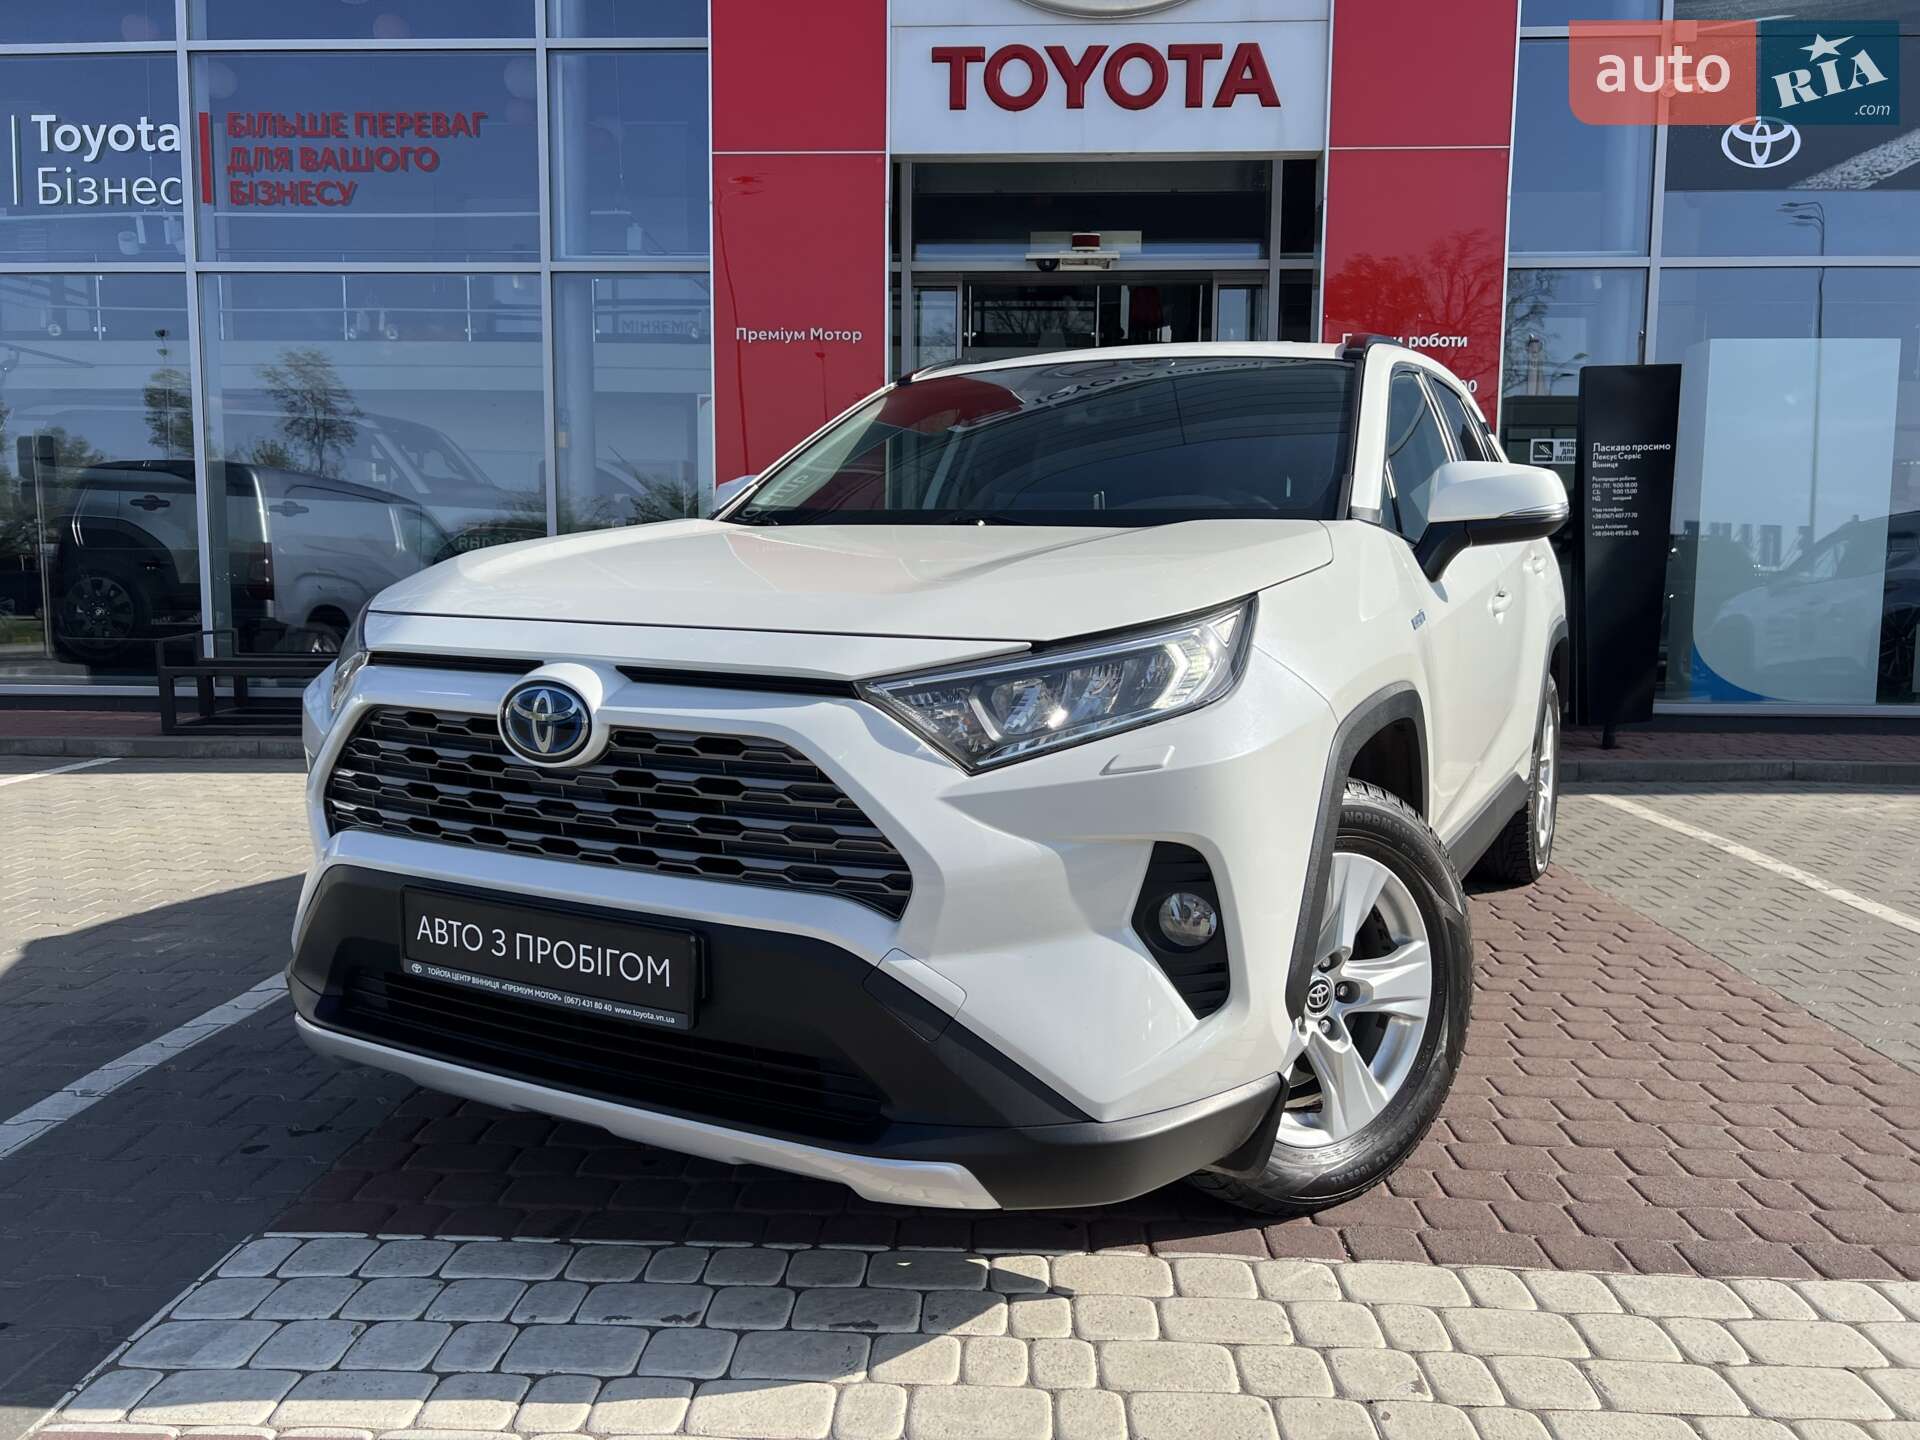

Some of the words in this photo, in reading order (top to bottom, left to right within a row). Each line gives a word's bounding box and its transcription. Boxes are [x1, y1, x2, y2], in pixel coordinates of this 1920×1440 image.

[931, 43, 1282, 111] TOYOTA
[31, 114, 181, 162] Toyota
[226, 112, 349, 138] БІЛЬШЕ
[354, 112, 488, 138] ПЕРЕВАГ
[226, 146, 292, 174] ДЛЯ
[299, 146, 441, 174] ВАШОГО
[37, 167, 182, 206] Бізнес
[229, 180, 357, 206] БІЗНЕСУ
[736, 327, 806, 344] Преміум
[810, 328, 863, 344] Мотор
[1408, 333, 1469, 349] роботи
[1632, 443, 1671, 453] просимо
[416, 915, 483, 951] АВТО
[491, 929, 506, 957] З
[516, 932, 670, 988] ПРОБІГОМ
[427, 967, 451, 979] ТОЙОТА
[451, 972, 471, 983] ЦЕНТР
[472, 975, 500, 989] ВІННИЦЯ
[564, 996, 581, 1006] (067)
[582, 1000, 593, 1008] 431
[594, 1002, 602, 1010] 80
[604, 1004, 612, 1012] 40
[614, 1007, 675, 1024] www.toyota.vn.ua
